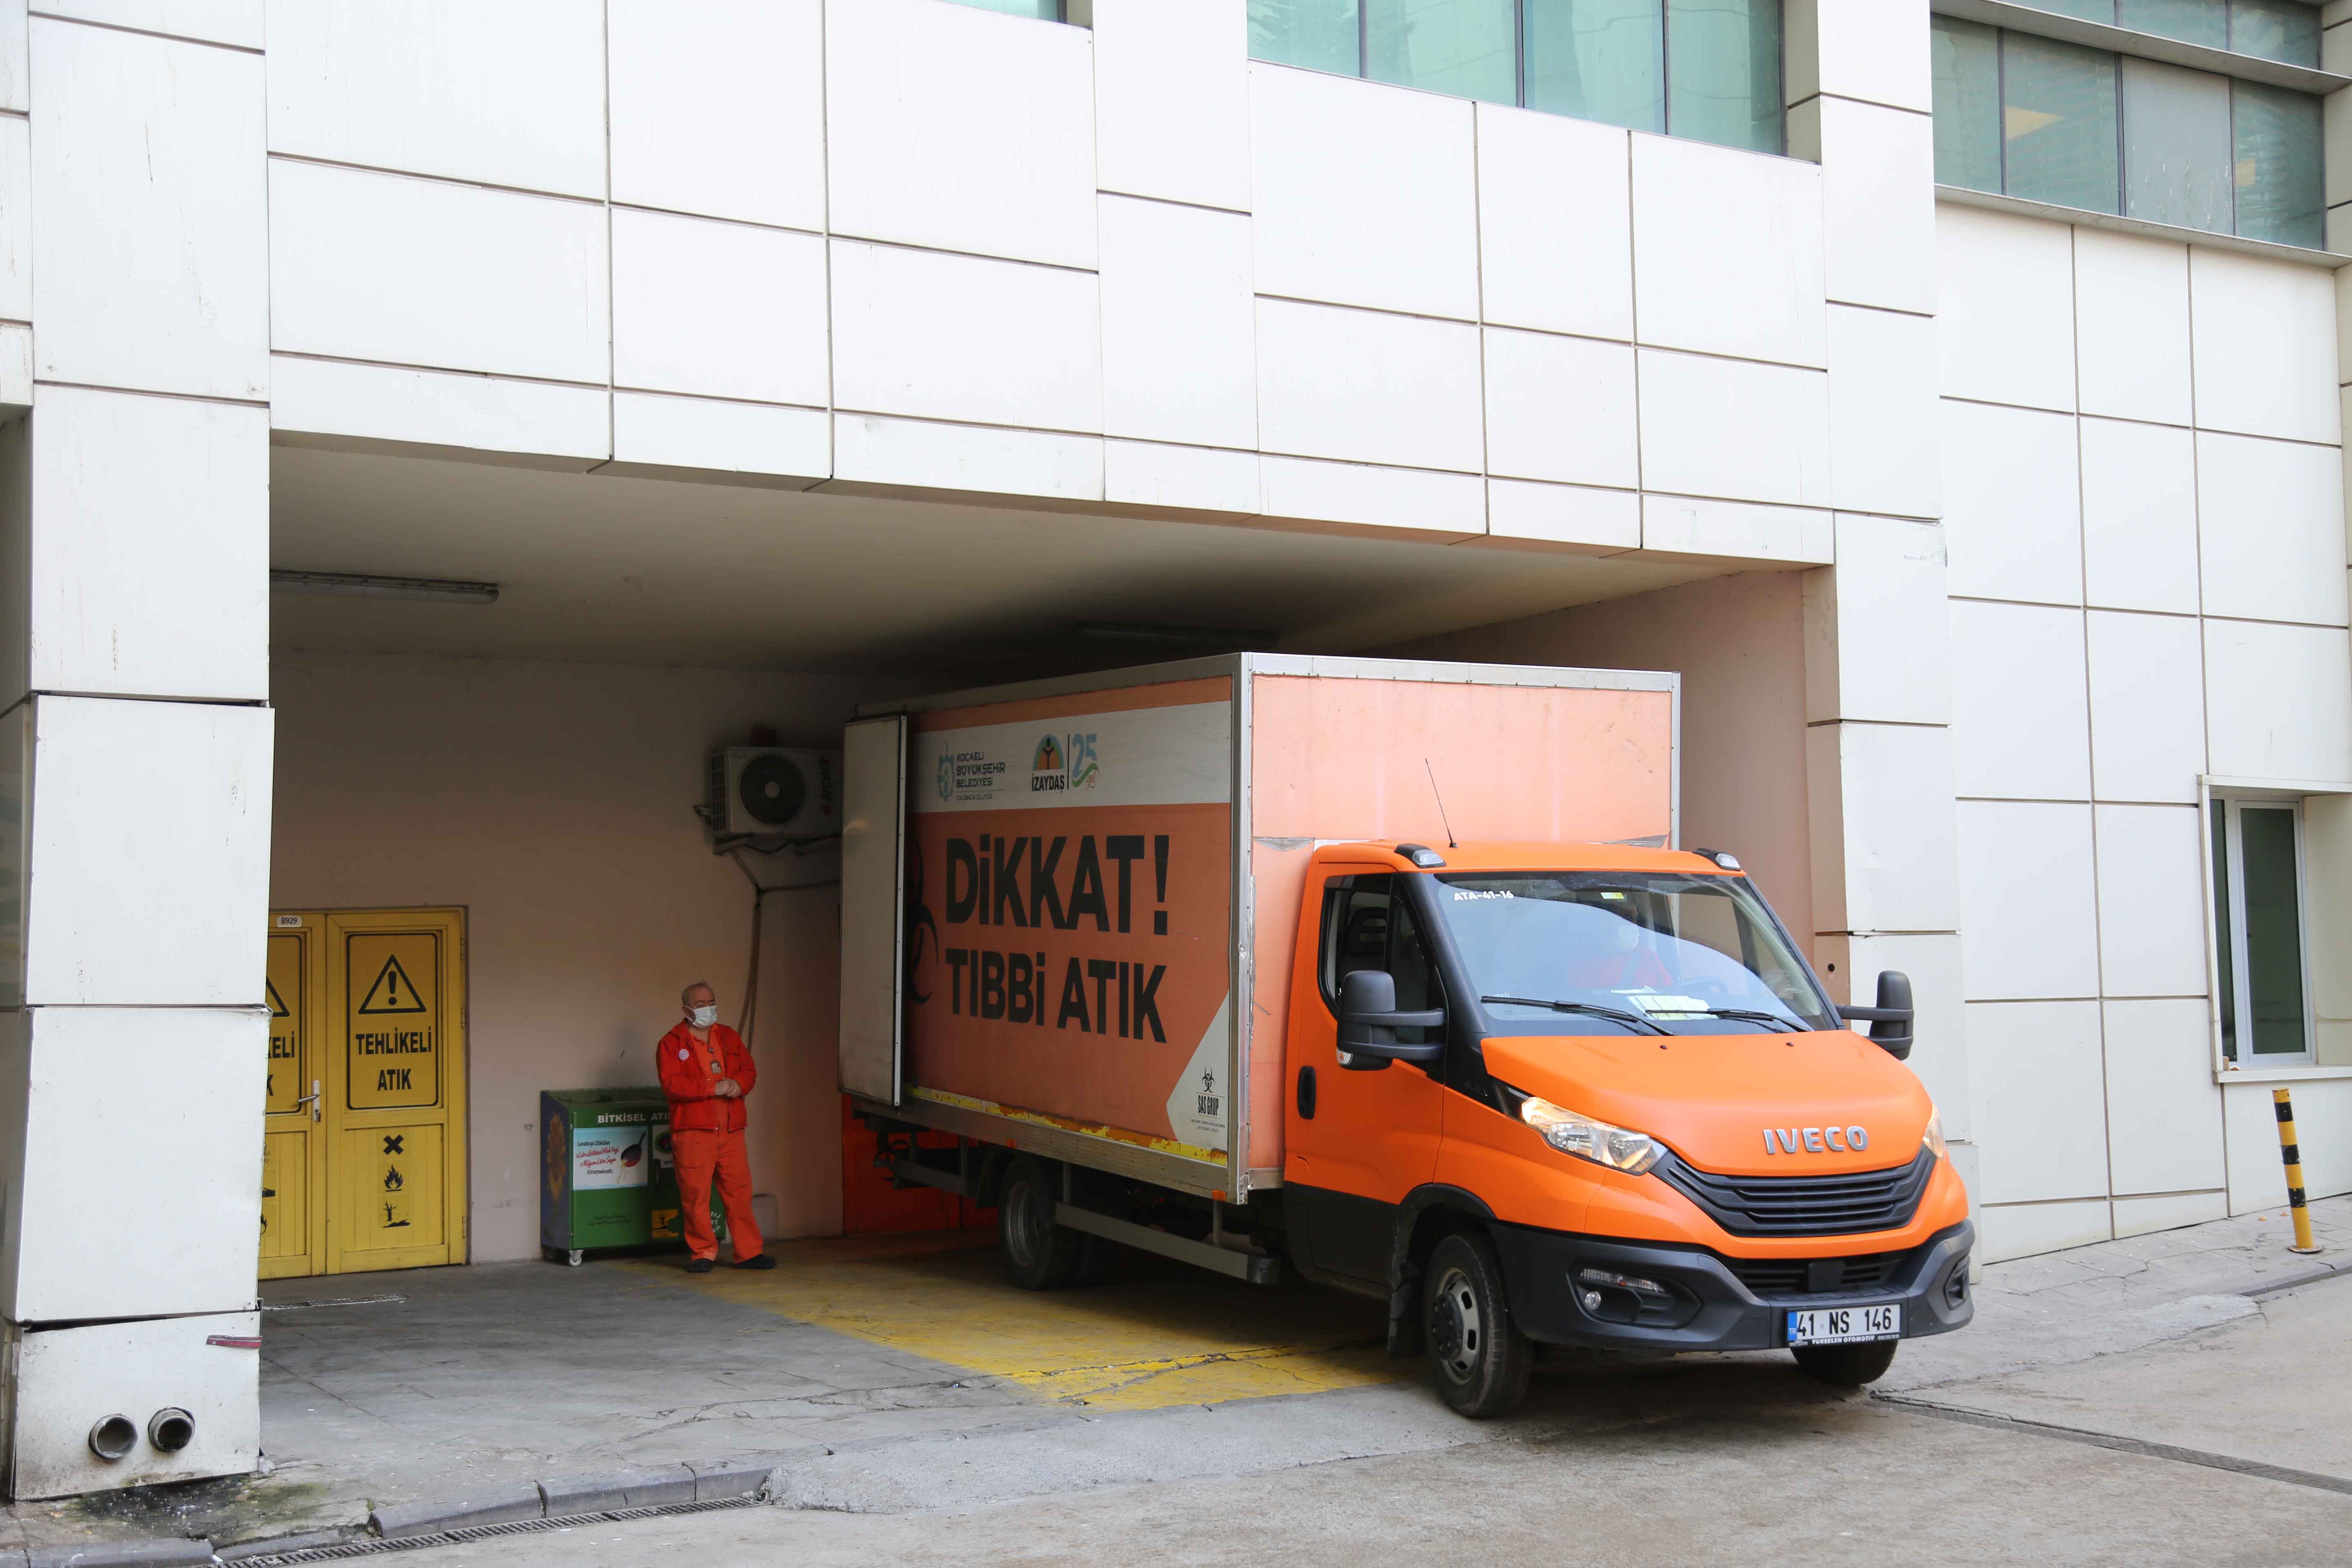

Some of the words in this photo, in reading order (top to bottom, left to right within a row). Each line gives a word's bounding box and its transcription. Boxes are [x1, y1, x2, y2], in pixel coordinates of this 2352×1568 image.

[1072, 734, 1097, 778] 25
[1031, 774, 1065, 793] İZAYDAŞ
[1454, 890, 1514, 901] ATA-41-16
[1057, 957, 1167, 1043] ATIK
[356, 1026, 432, 1055] TEHLİKELİ
[377, 1068, 412, 1091] ATIK
[598, 1113, 646, 1123] BİTKİSEL
[1207, 1096, 1219, 1116] GRUP
[1763, 1126, 1869, 1155] IVECO
[1797, 1314, 1814, 1336] 41
[1829, 1311, 1849, 1334] NS
[1865, 1307, 1891, 1332] 146
